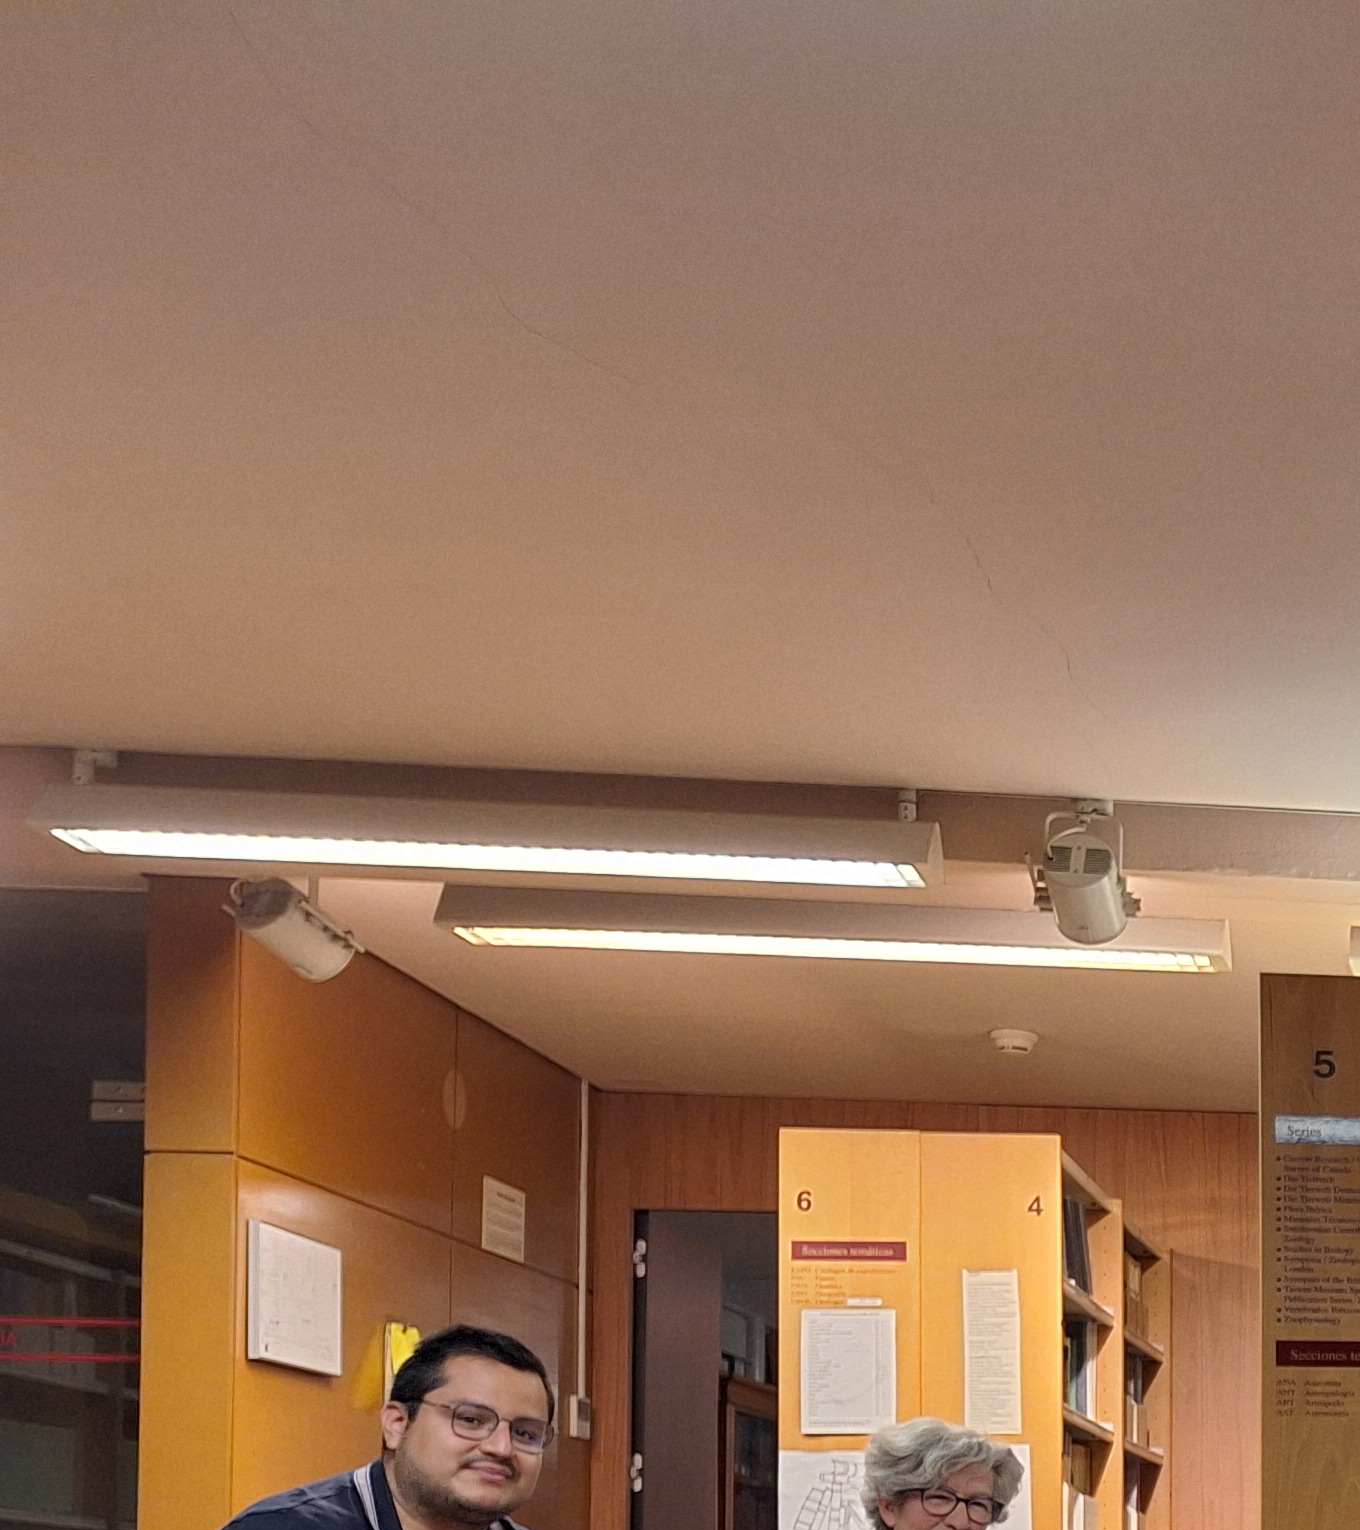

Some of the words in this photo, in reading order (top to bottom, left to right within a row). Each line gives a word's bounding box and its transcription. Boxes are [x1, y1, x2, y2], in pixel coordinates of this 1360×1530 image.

[1314, 1051, 1336, 1079] 5
[1287, 1125, 1322, 1139] Series
[796, 1190, 812, 1212] 6
[1027, 1195, 1044, 1217] 4
[1290, 1349, 1347, 1361] Secciones
